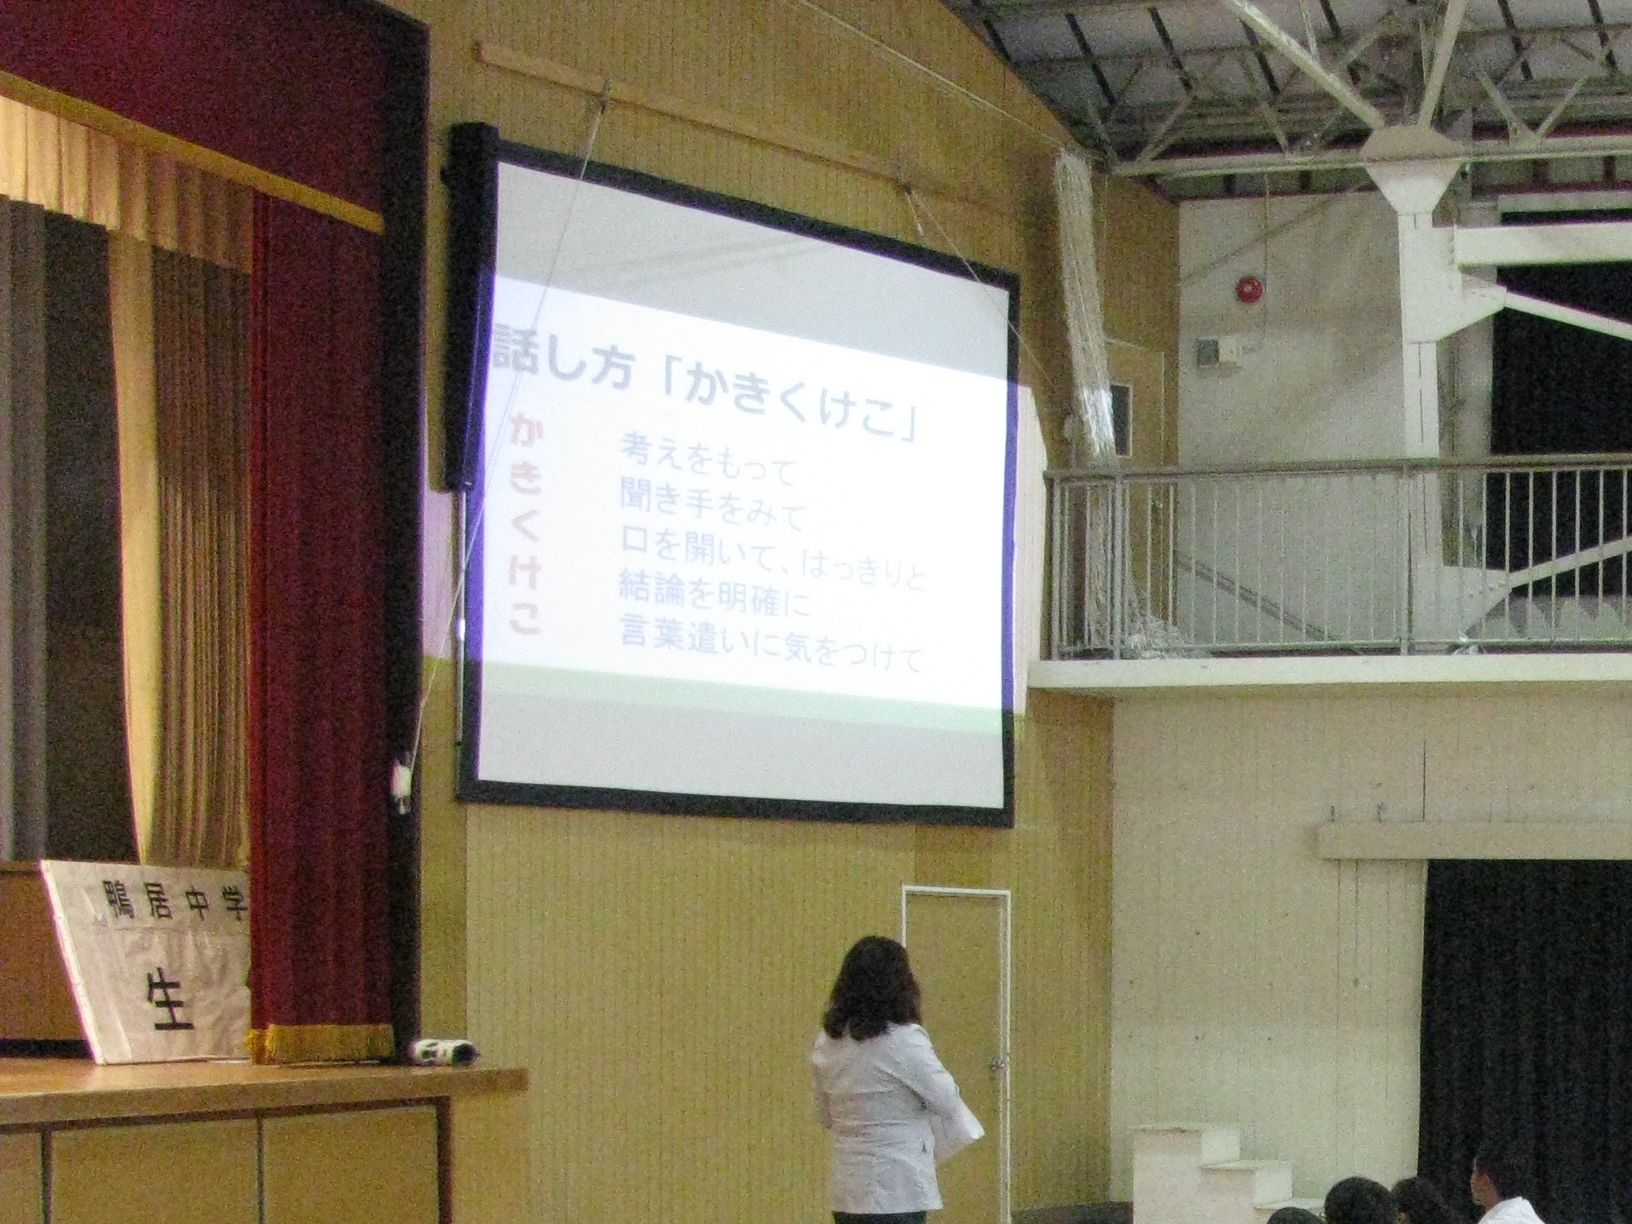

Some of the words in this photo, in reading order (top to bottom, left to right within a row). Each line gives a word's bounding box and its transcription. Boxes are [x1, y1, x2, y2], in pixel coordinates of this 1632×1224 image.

[492, 322, 917, 442] 話し方「かきくけこ」
[620, 429, 798, 486] 考えをもって
[620, 475, 807, 533] 聞き手をみて
[621, 525, 928, 592] 口を開いて、はっきりと
[618, 566, 812, 618] 結論を明確に
[620, 612, 925, 674] 言葉遣いに気をつけて
[146, 967, 195, 1031] 生
